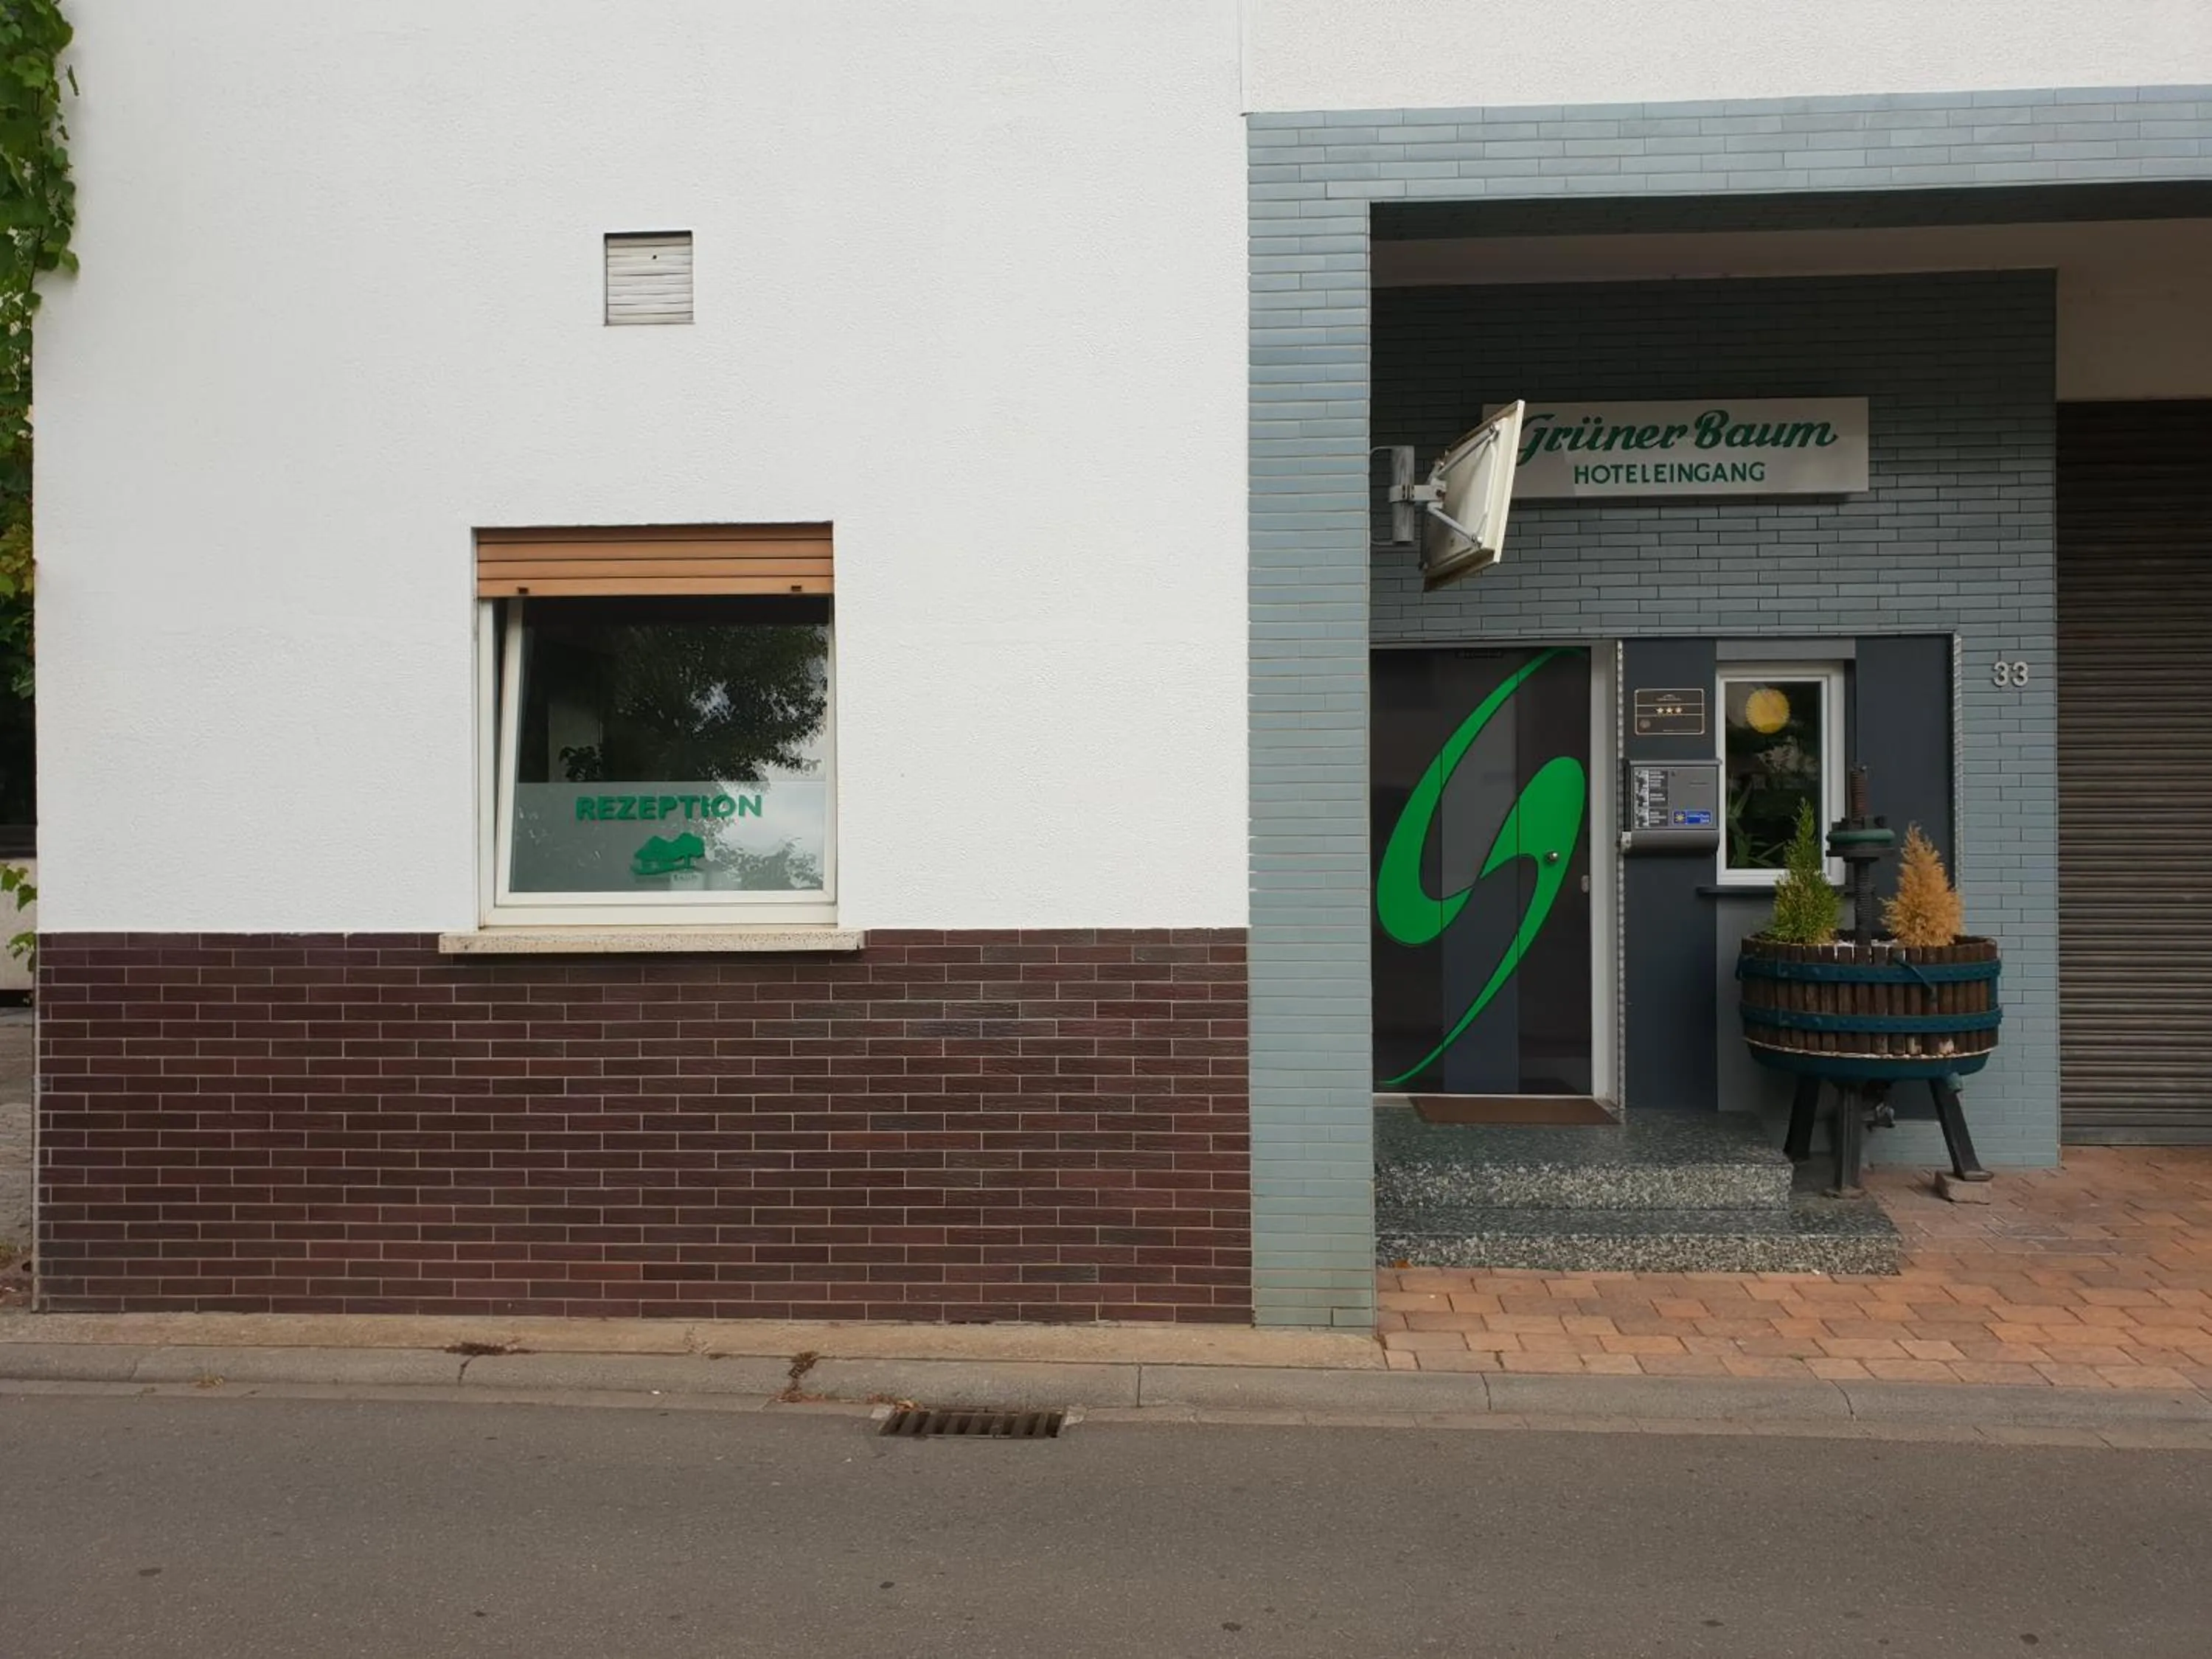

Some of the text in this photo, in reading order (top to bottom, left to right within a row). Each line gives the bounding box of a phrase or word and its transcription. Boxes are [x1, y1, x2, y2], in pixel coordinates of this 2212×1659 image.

[1517, 409, 1838, 466] Grüner Baum
[1574, 462, 1765, 484] HOTELEINGANG
[1992, 661, 2029, 686] 33
[576, 795, 762, 820] REZEPTION
